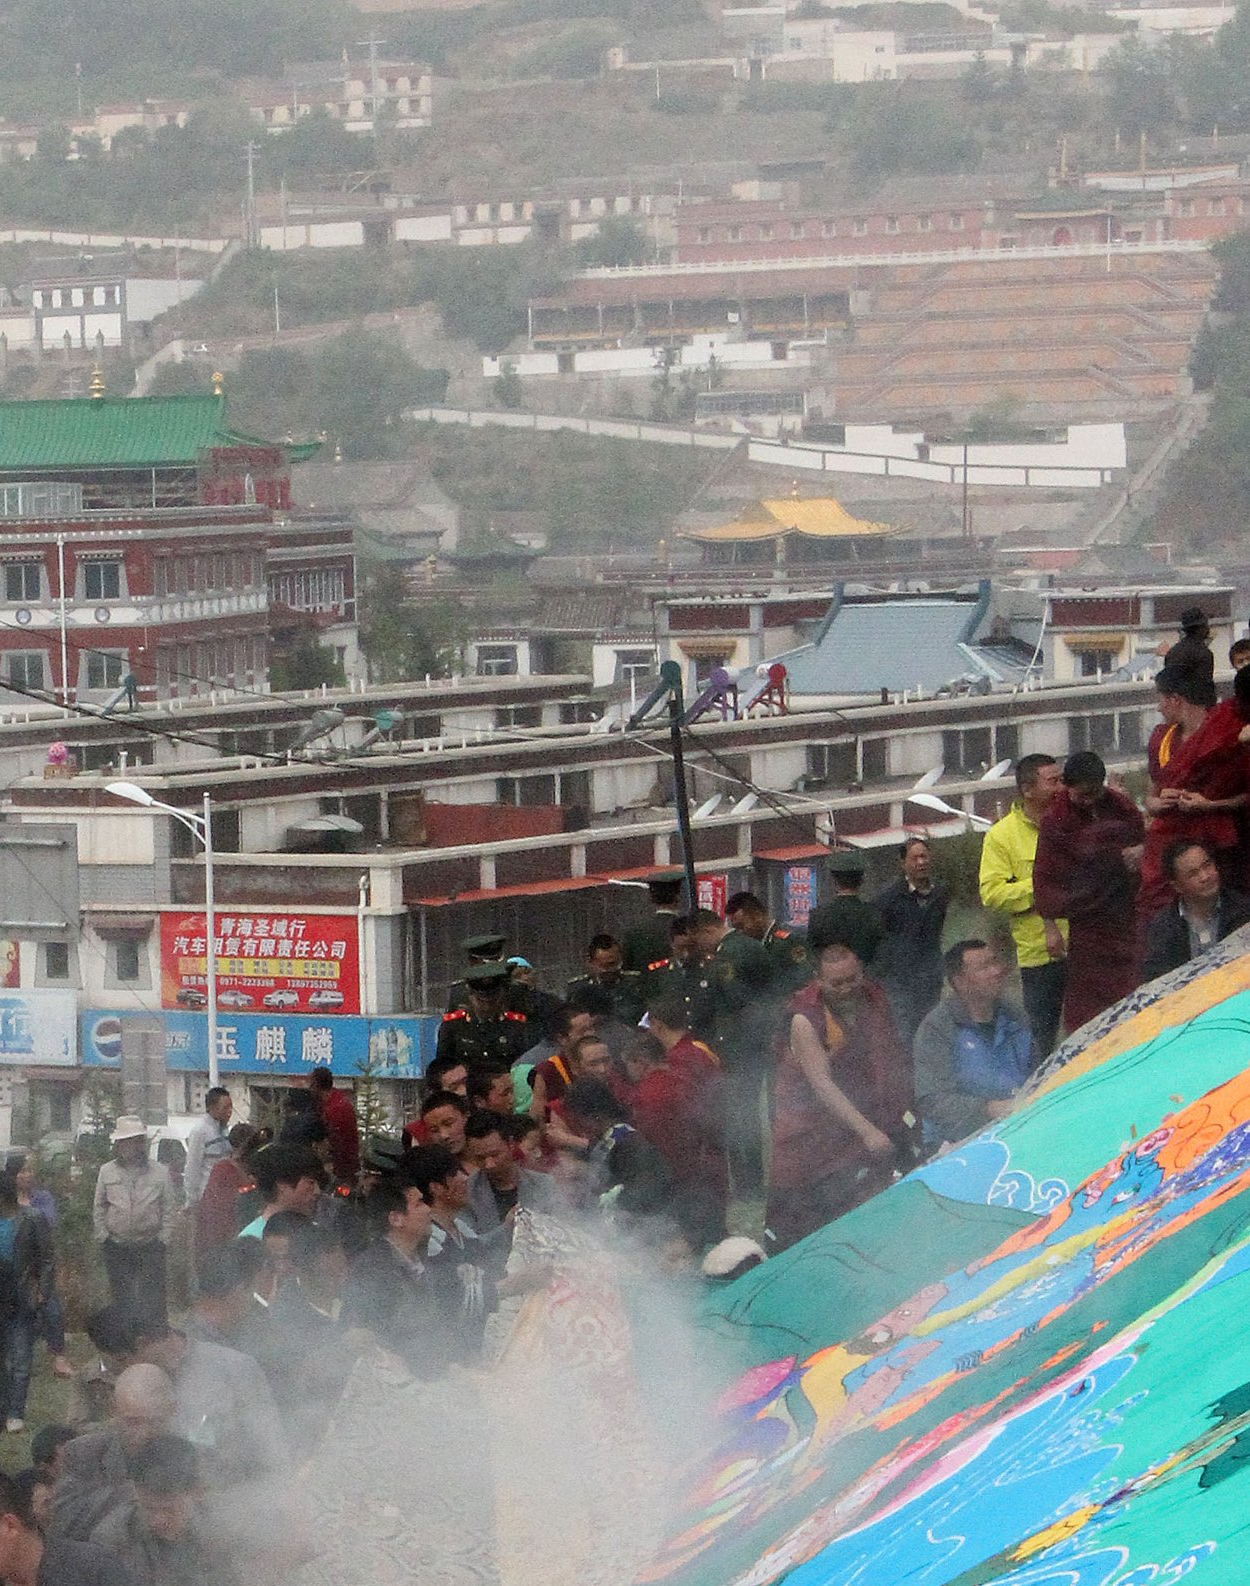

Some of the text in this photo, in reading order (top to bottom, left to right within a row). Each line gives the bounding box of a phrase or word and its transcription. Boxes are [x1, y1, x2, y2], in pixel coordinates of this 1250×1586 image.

[220, 917, 306, 938] 青海圣域行
